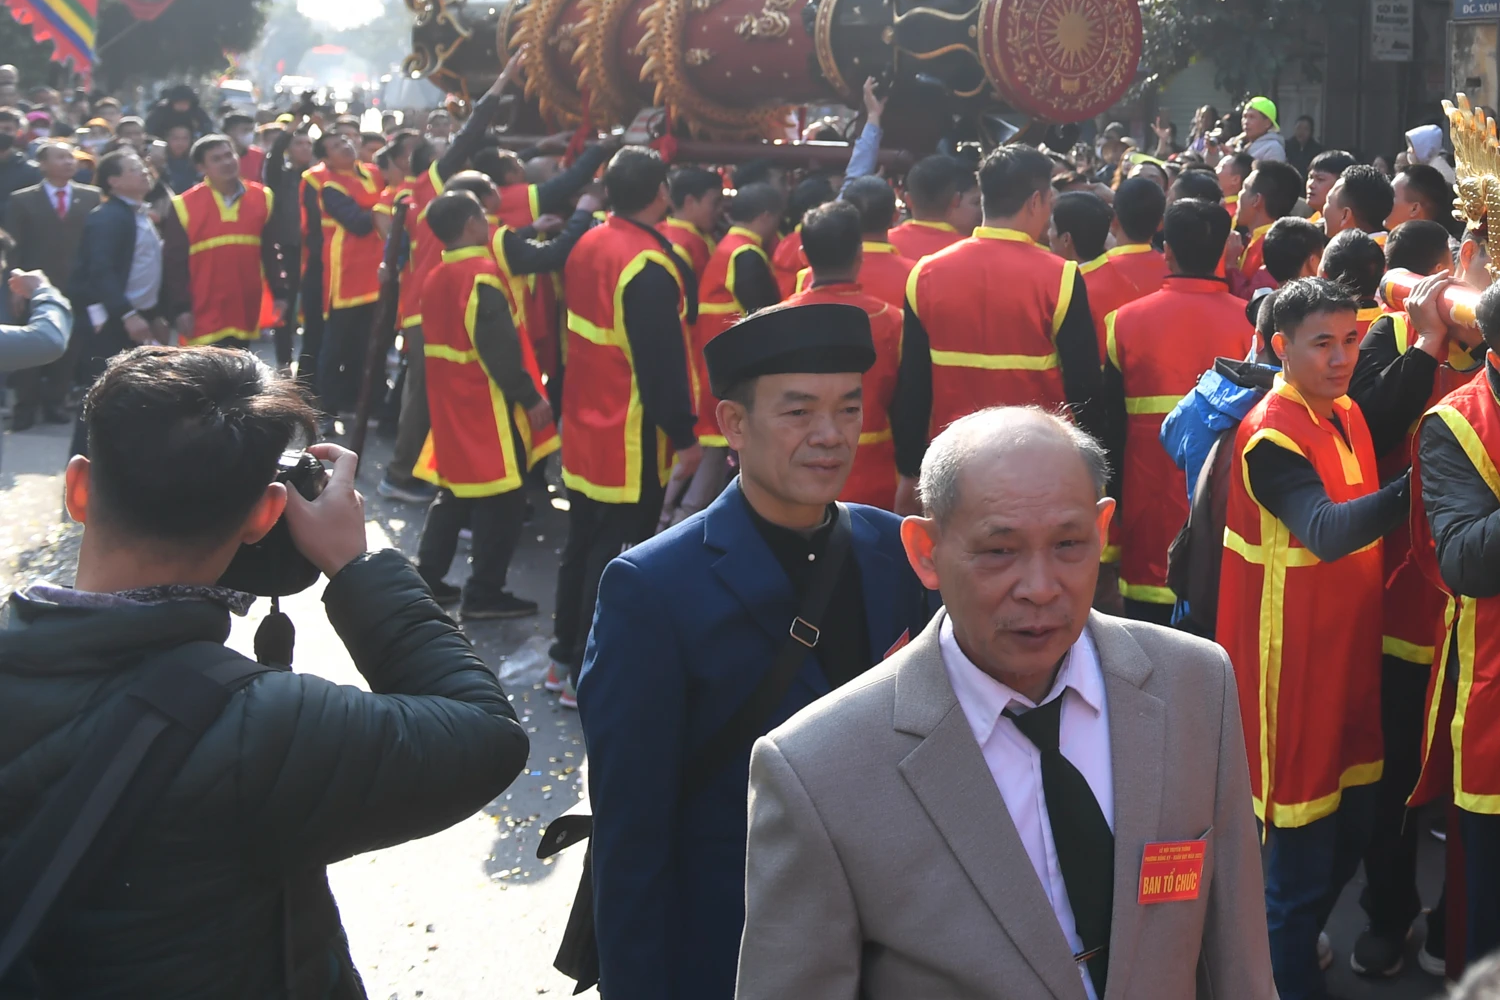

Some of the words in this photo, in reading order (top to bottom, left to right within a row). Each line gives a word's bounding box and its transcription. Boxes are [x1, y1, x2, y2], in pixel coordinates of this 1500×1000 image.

[1142, 876, 1162, 895] BAN
[1163, 867, 1176, 893] TỔ
[1175, 868, 1198, 892] CHỨC
